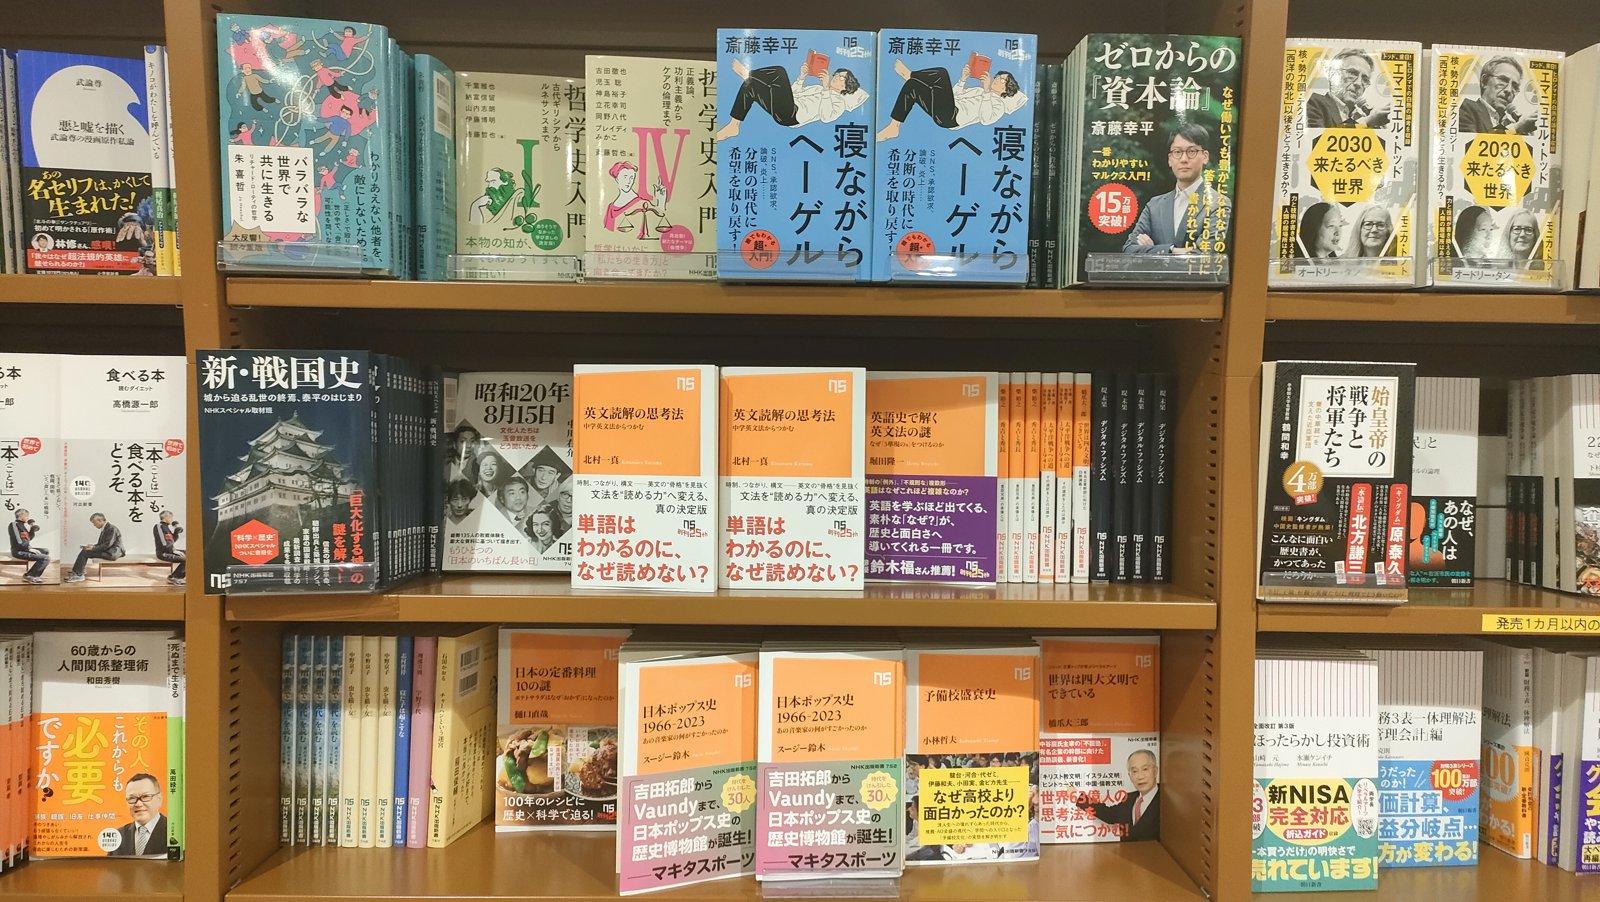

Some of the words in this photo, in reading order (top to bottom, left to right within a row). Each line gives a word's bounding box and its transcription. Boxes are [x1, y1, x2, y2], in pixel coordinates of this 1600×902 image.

[725, 36, 799, 55] 斎藤幸平
[888, 37, 961, 56] 斎藤幸平
[1094, 41, 1237, 74] ゼロからの
[75, 78, 102, 88] 武論尊
[686, 67, 696, 99] 正義論、
[662, 66, 672, 127] ケアの倫理まで
[674, 66, 684, 121] 功利主義から
[1091, 75, 1211, 112] 『資本論』
[540, 82, 550, 143] ルネサンスまで
[552, 82, 561, 152] 古代ギリシアから
[1391, 63, 1405, 179] エマニュエル・トッド
[58, 119, 124, 135] 悪と嘘を描く
[1091, 121, 1155, 136] 斎藤幸平
[1536, 71, 1551, 185] エマニュエル・トッド
[595, 133, 618, 142] みかこ
[1326, 134, 1373, 154] 2030
[234, 153, 245, 164] 朱
[1092, 147, 1112, 156] 一番
[1478, 140, 1521, 159] 2030
[1091, 159, 1149, 169] わかりやすい
[1313, 156, 1385, 176] 来たるべき
[1466, 160, 1532, 179] 来たるべき
[41, 170, 62, 180] あの
[277, 155, 291, 196] 世界で
[1091, 170, 1151, 182] マルクス入門!
[27, 174, 151, 200] 名セリフは、かくして
[260, 154, 275, 223] 共に生きる
[295, 156, 309, 224] バラバラな
[744, 147, 759, 229] 分断の時代に
[833, 122, 869, 268] 寝ながら
[901, 149, 917, 230] 分断の時代に
[1332, 178, 1364, 196] 世界
[1483, 182, 1513, 201] 世界
[785, 133, 825, 267] ヘーゲル
[989, 125, 1028, 271] 寝ながら
[1097, 214, 1128, 228] 突破!
[465, 236, 533, 251] 本物の知が、
[106, 367, 166, 383] 食べる本
[201, 355, 363, 390] 新・戦国史
[474, 382, 570, 403] 昭和20年
[676, 376, 695, 391] ns
[828, 379, 847, 394] ns
[112, 399, 159, 409] 高橋源一郎
[584, 406, 684, 421] 英文読解の思考法
[483, 404, 555, 426] 8月15日
[732, 408, 836, 422] 英文読解の思考法
[871, 411, 938, 425] 英語史で解く
[1348, 385, 1369, 449] 戦争と
[583, 422, 645, 430] 中学英文法からつかむ
[732, 424, 794, 433] 中学英文法からつかむ
[870, 425, 932, 439] 英文法の謎
[1323, 385, 1347, 469] 将軍たち
[1367, 385, 1391, 469] 始皇帝の
[583, 454, 619, 465] 北村一真
[1099, 420, 1109, 482] デジタル・ファシズム
[1119, 423, 1129, 485] デジタル・ファシズム
[1135, 421, 1145, 484] デジタル・ファシズム
[1157, 423, 1167, 485] デジタル・ファシズム
[108, 442, 125, 493] どうぞ
[732, 456, 768, 466] 北村一真
[869, 456, 905, 466] 堀田隆一
[127, 442, 145, 524] 食べる本を
[655, 504, 708, 515] 真の決定版
[806, 504, 858, 516] 真の決定版
[869, 500, 989, 514] 英語を学ぶほど出てくる、
[577, 514, 636, 535] 単語は
[725, 515, 786, 536] 単語は
[1458, 499, 1474, 538] なぜ、
[868, 527, 943, 540] 歴史と面白さへ
[1271, 533, 1334, 545] こんなに面白い
[1441, 499, 1459, 561] あの人は
[449, 546, 494, 555] もうひとつの
[576, 538, 682, 559] わかるのに、
[725, 539, 832, 559] わかるのに、
[869, 540, 978, 555] 導いてくれる一冊です。
[1279, 546, 1323, 557] 歴史書が、
[577, 562, 709, 583] なぜ読めない?
[725, 563, 859, 583] なぜ読めない?
[1273, 558, 1327, 569] かつてあった
[70, 644, 136, 657] 60歳からの
[57, 658, 150, 673] 人間関係整理術
[170, 643, 180, 699] 死ぬまで生きる
[515, 666, 597, 678] 日本の定番料理
[86, 675, 121, 685] 和田秀樹
[515, 681, 552, 692] 10の謎
[1048, 673, 1140, 686] 世界は四大文明で
[777, 694, 854, 709] 日本ポップス史
[924, 688, 997, 703] 予備校盛衰史
[1048, 688, 1096, 699] できている
[642, 698, 718, 719] 日本ポップス史
[777, 710, 842, 724] 1966-2023
[642, 715, 706, 734] 1966-2023
[1048, 717, 1090, 728] 橋爪大三郎
[129, 715, 151, 775] その人、
[777, 742, 826, 754] スージー鈴木
[1253, 733, 1371, 749] ほったらかし投資術
[62, 716, 109, 805] 必要
[111, 715, 128, 793] これからも
[643, 750, 690, 765] スージー鈴木
[768, 769, 851, 788] 吉田拓郎から
[1380, 765, 1417, 778] うだった
[633, 777, 713, 802] 吉田拓郎から
[769, 788, 859, 810] Vaundyまで、
[933, 788, 1015, 804] なぜ高校より
[1040, 788, 1129, 806] 世界63億人の
[1268, 784, 1350, 806] 新NISA
[502, 796, 586, 808] 100年のレシピに
[633, 797, 721, 822] Vaundyまで、
[767, 808, 882, 829] 日本ポップス史の
[923, 804, 1026, 821] 面白かったのか?
[1040, 806, 1098, 823] 思考法を
[1269, 806, 1350, 827] 完全対応
[632, 812, 741, 843] 日本ポップス史の
[1040, 823, 1130, 840] 一気につかむ!
[1284, 829, 1327, 840] 折込ガイド
[631, 830, 752, 863] 歴史博物館が誕生!
[767, 828, 893, 848] 歴史博物館が誕生!
